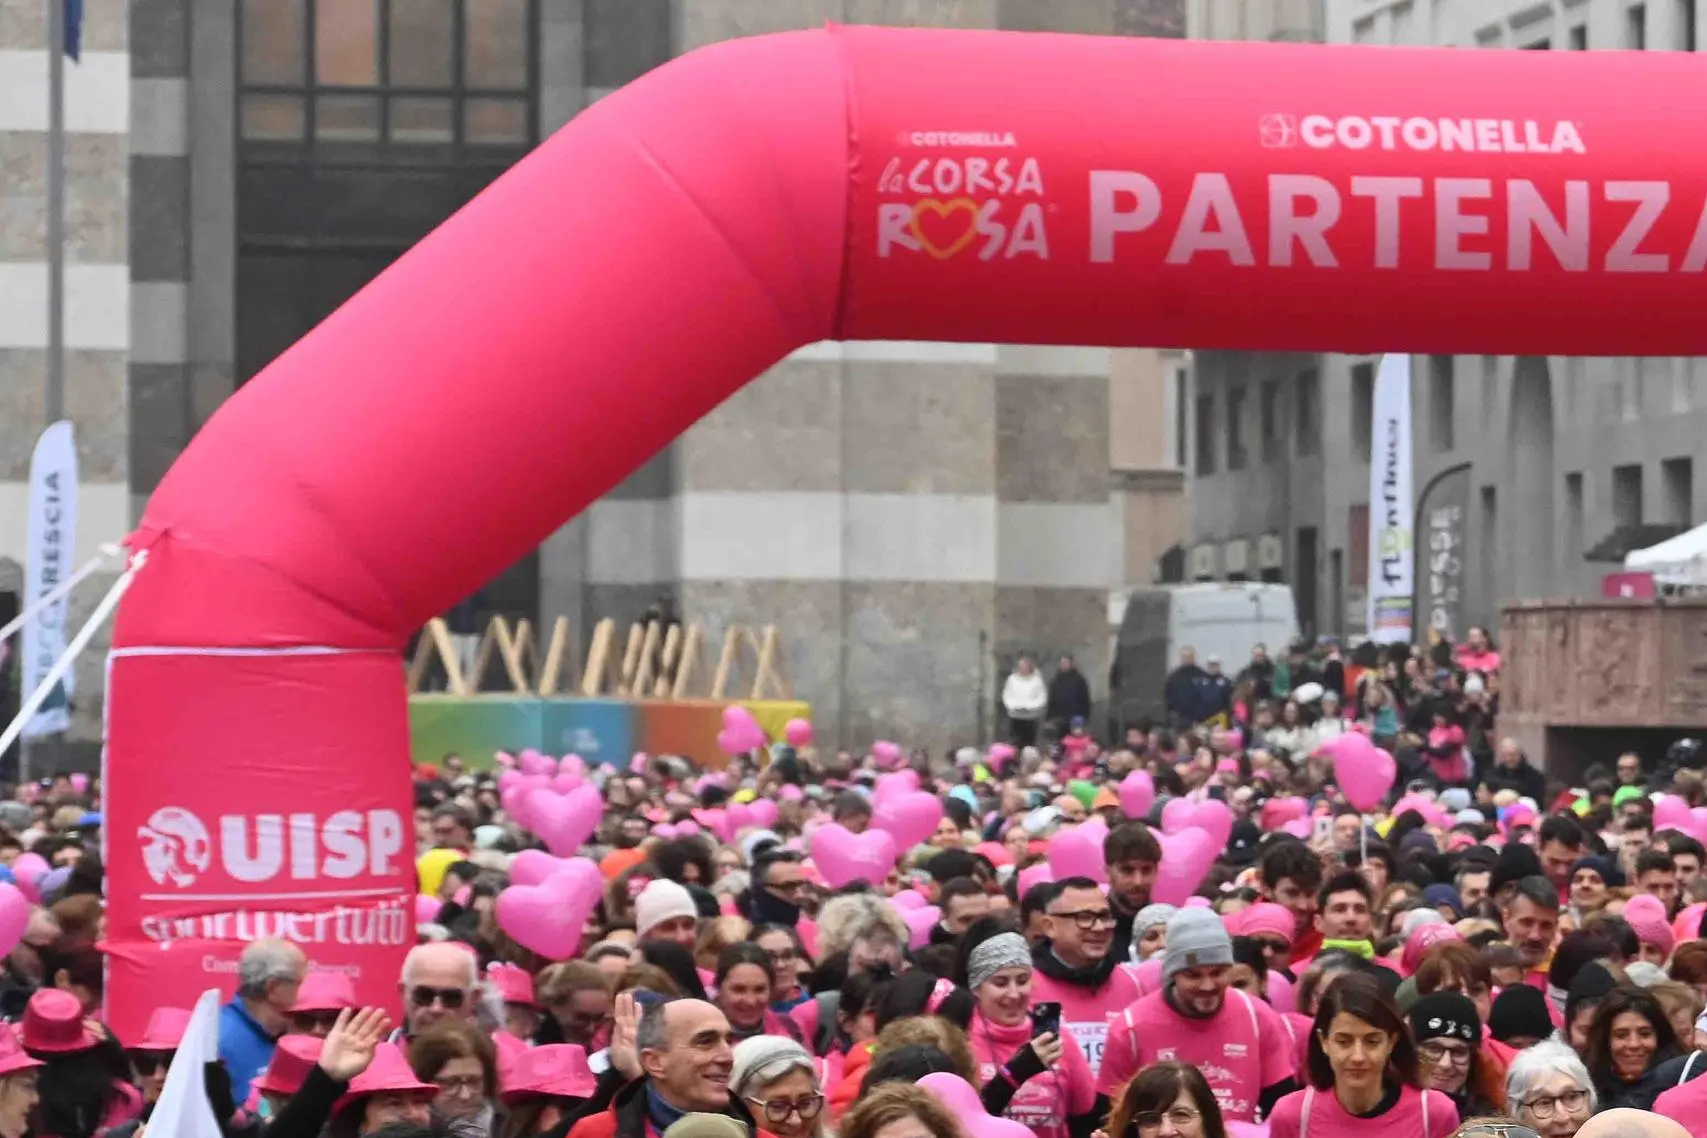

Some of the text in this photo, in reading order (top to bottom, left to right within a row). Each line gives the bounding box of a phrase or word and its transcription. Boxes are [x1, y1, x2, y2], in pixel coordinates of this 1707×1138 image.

[910, 132, 1017, 147] COTONELLA
[1300, 114, 1588, 154] COTONELLA
[907, 157, 1045, 196] CORSA
[219, 808, 404, 882] UISP
